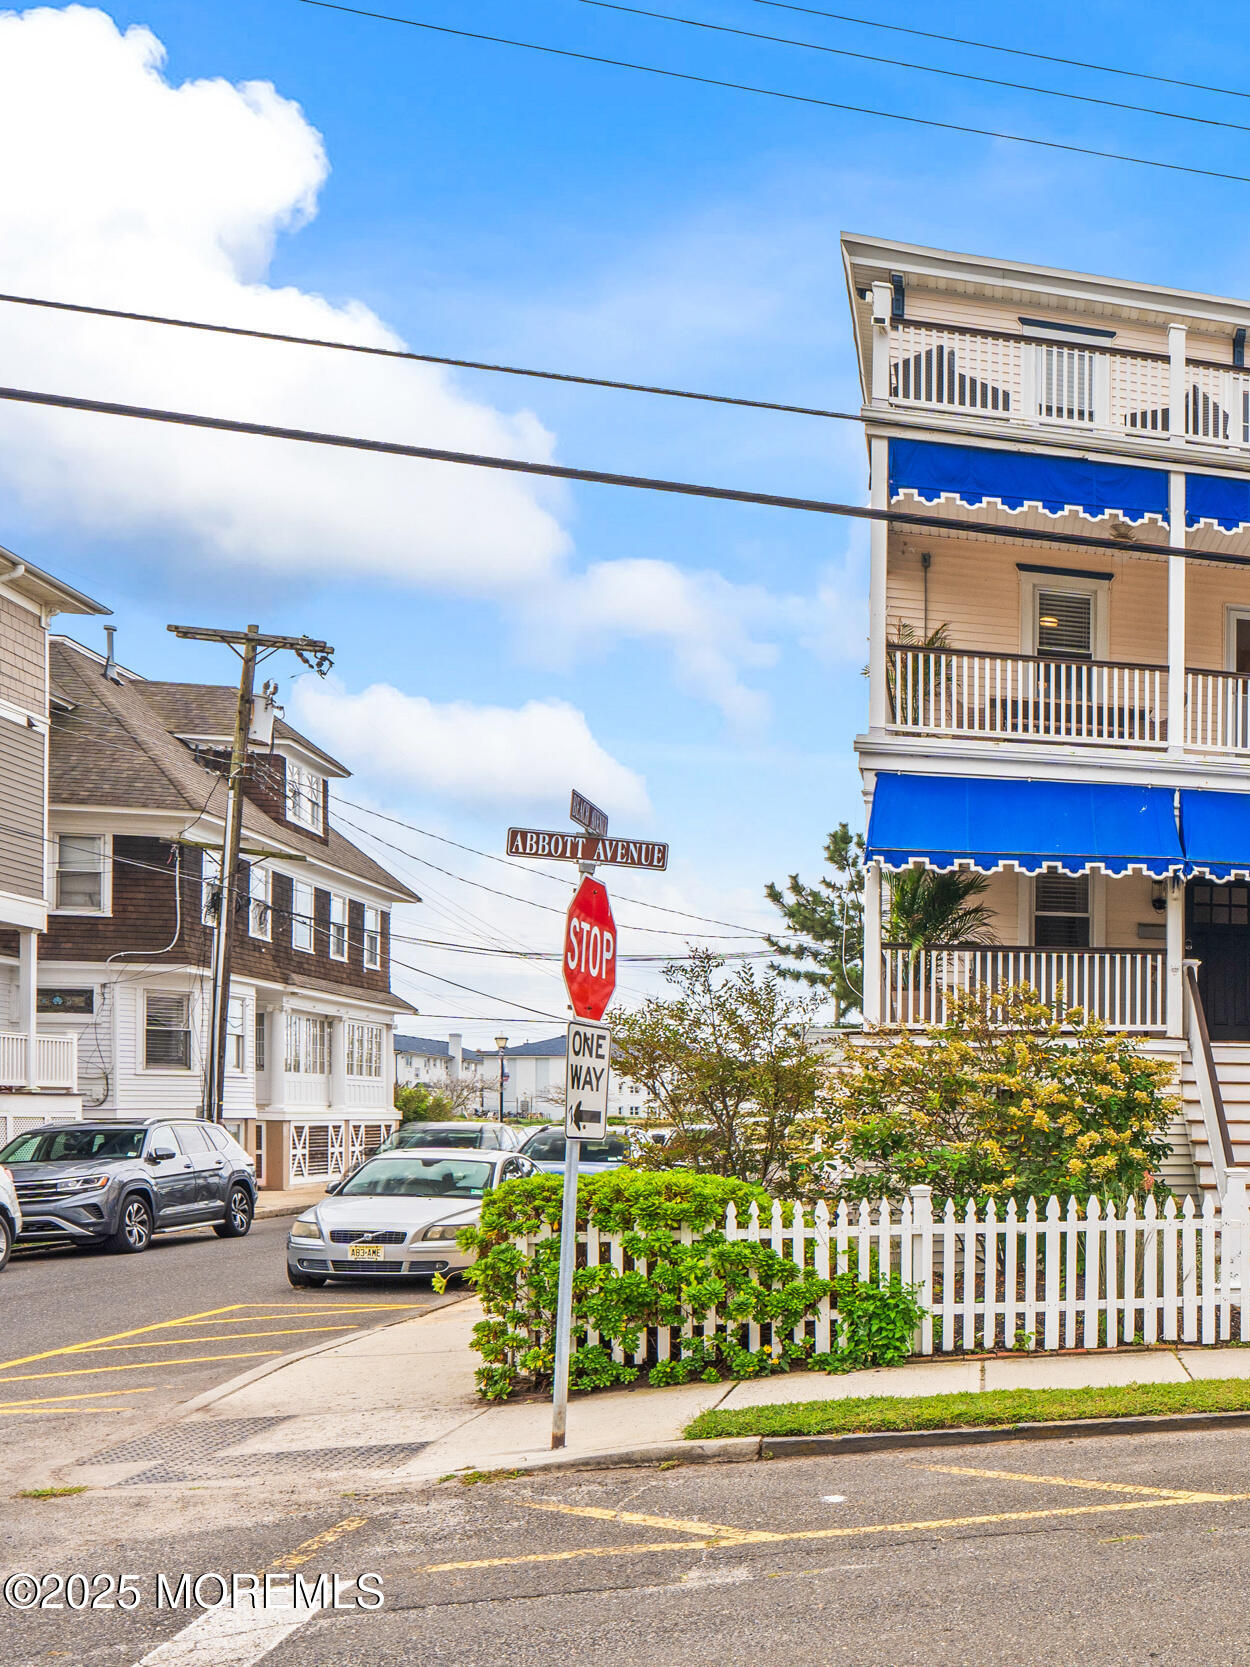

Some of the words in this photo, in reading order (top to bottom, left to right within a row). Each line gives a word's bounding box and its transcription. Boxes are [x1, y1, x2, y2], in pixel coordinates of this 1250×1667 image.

[511, 832, 586, 858] ABBOTT
[593, 839, 664, 866] AVENUE
[567, 917, 614, 979] STOP
[572, 1030, 607, 1060] ONE
[570, 1063, 605, 1092] WAY
